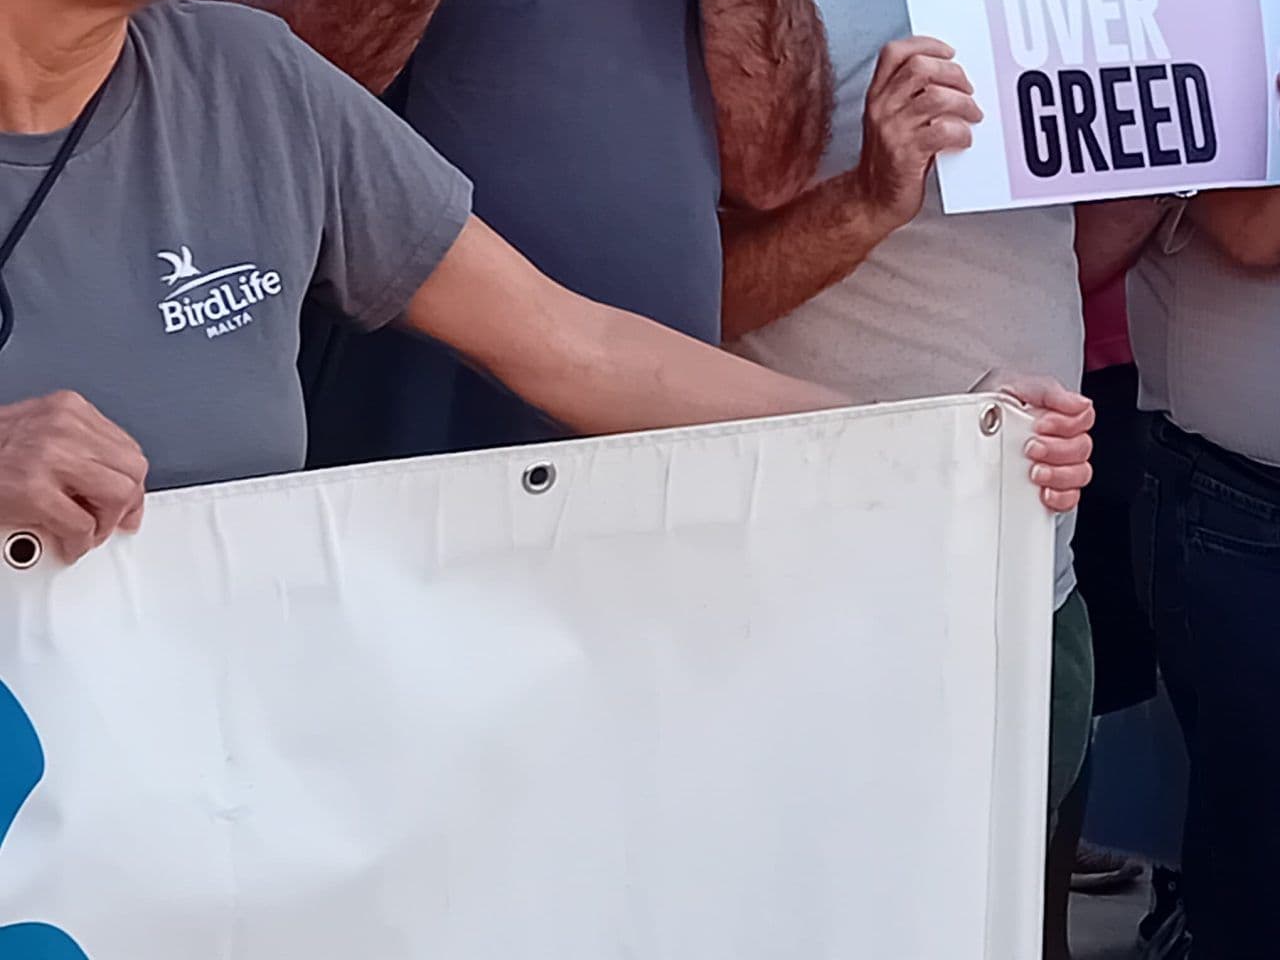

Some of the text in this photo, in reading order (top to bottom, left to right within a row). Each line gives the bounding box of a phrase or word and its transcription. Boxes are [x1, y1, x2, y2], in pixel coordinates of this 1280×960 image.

[1017, 63, 1217, 178] GREED
[158, 271, 282, 333] BirdLife
[206, 312, 253, 339] MALTA
